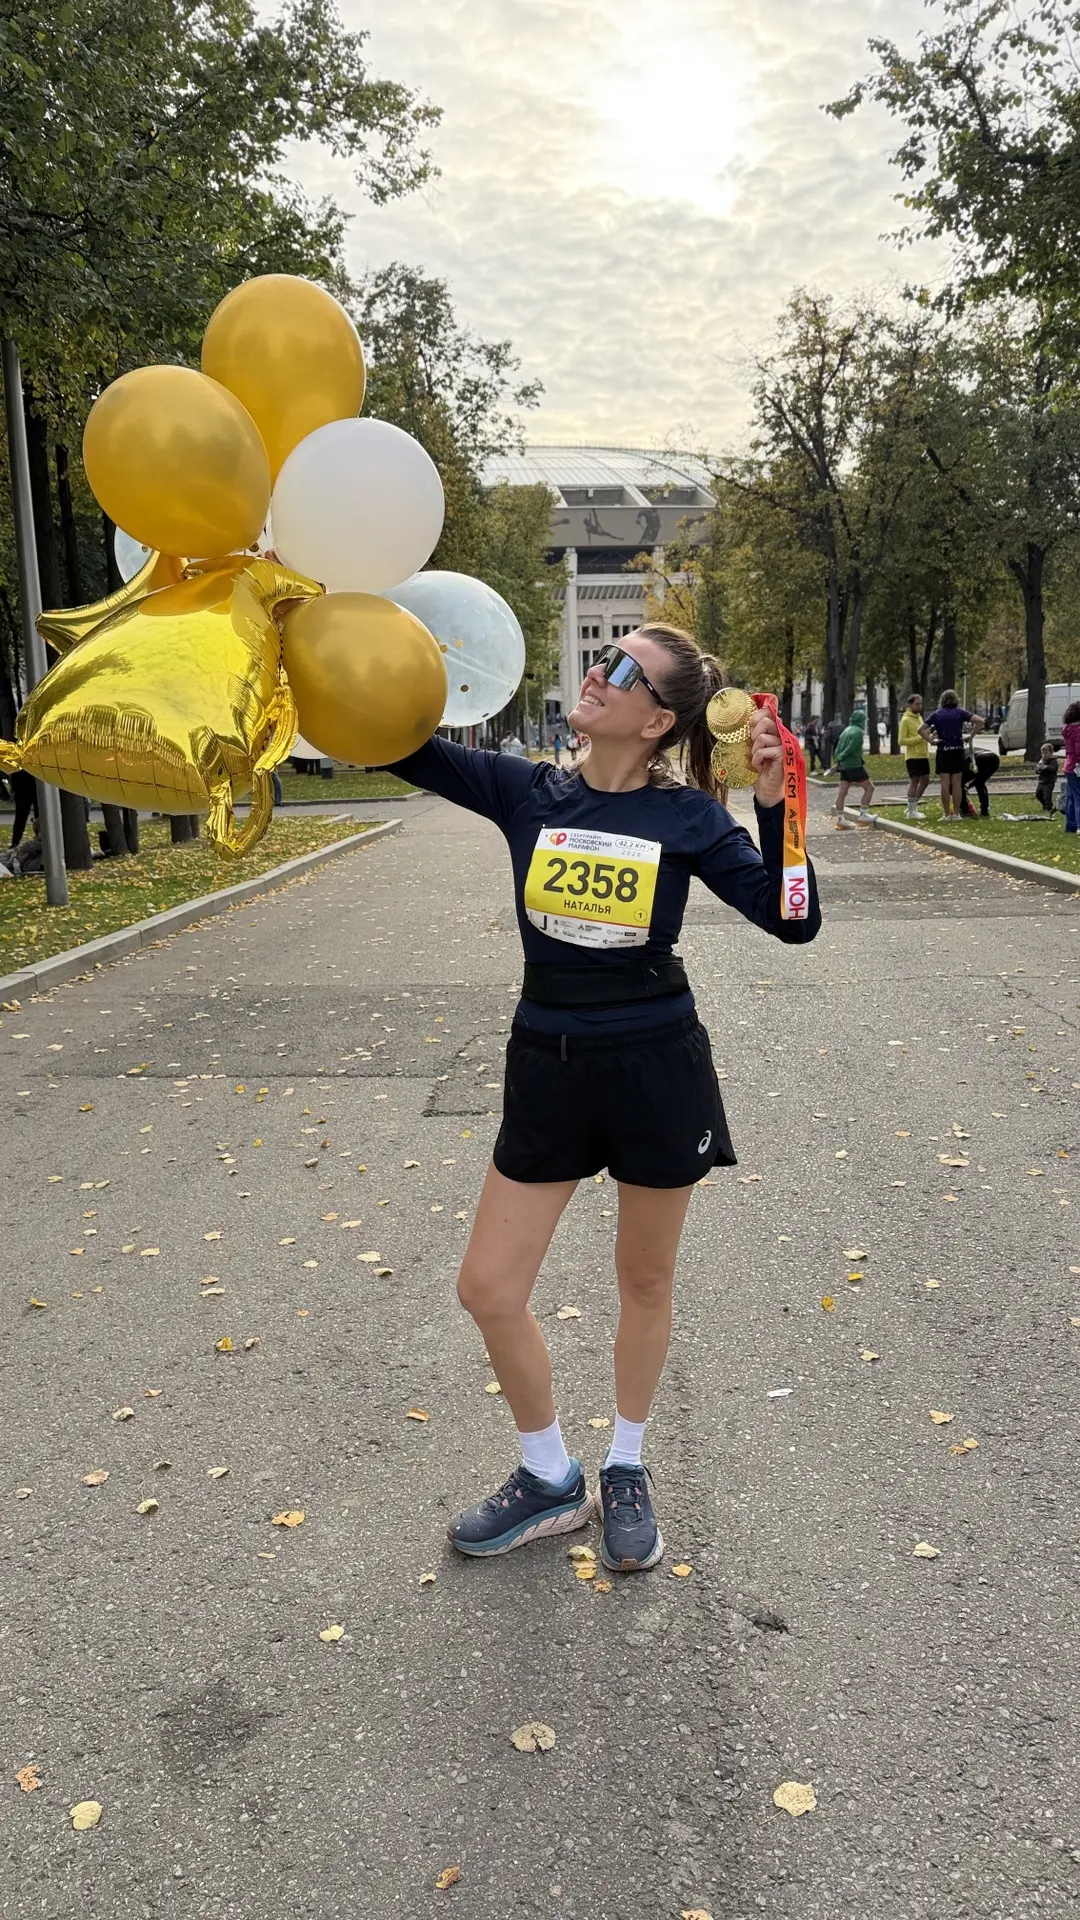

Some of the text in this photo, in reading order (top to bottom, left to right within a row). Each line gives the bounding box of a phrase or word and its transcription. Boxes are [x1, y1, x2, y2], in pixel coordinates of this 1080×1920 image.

[568, 843, 600, 852] МАРАФОН
[569, 837, 613, 848] МОСКОВСКИЙ
[543, 857, 639, 903] 2358
[563, 899, 612, 915] НАТАЛЬЯ
